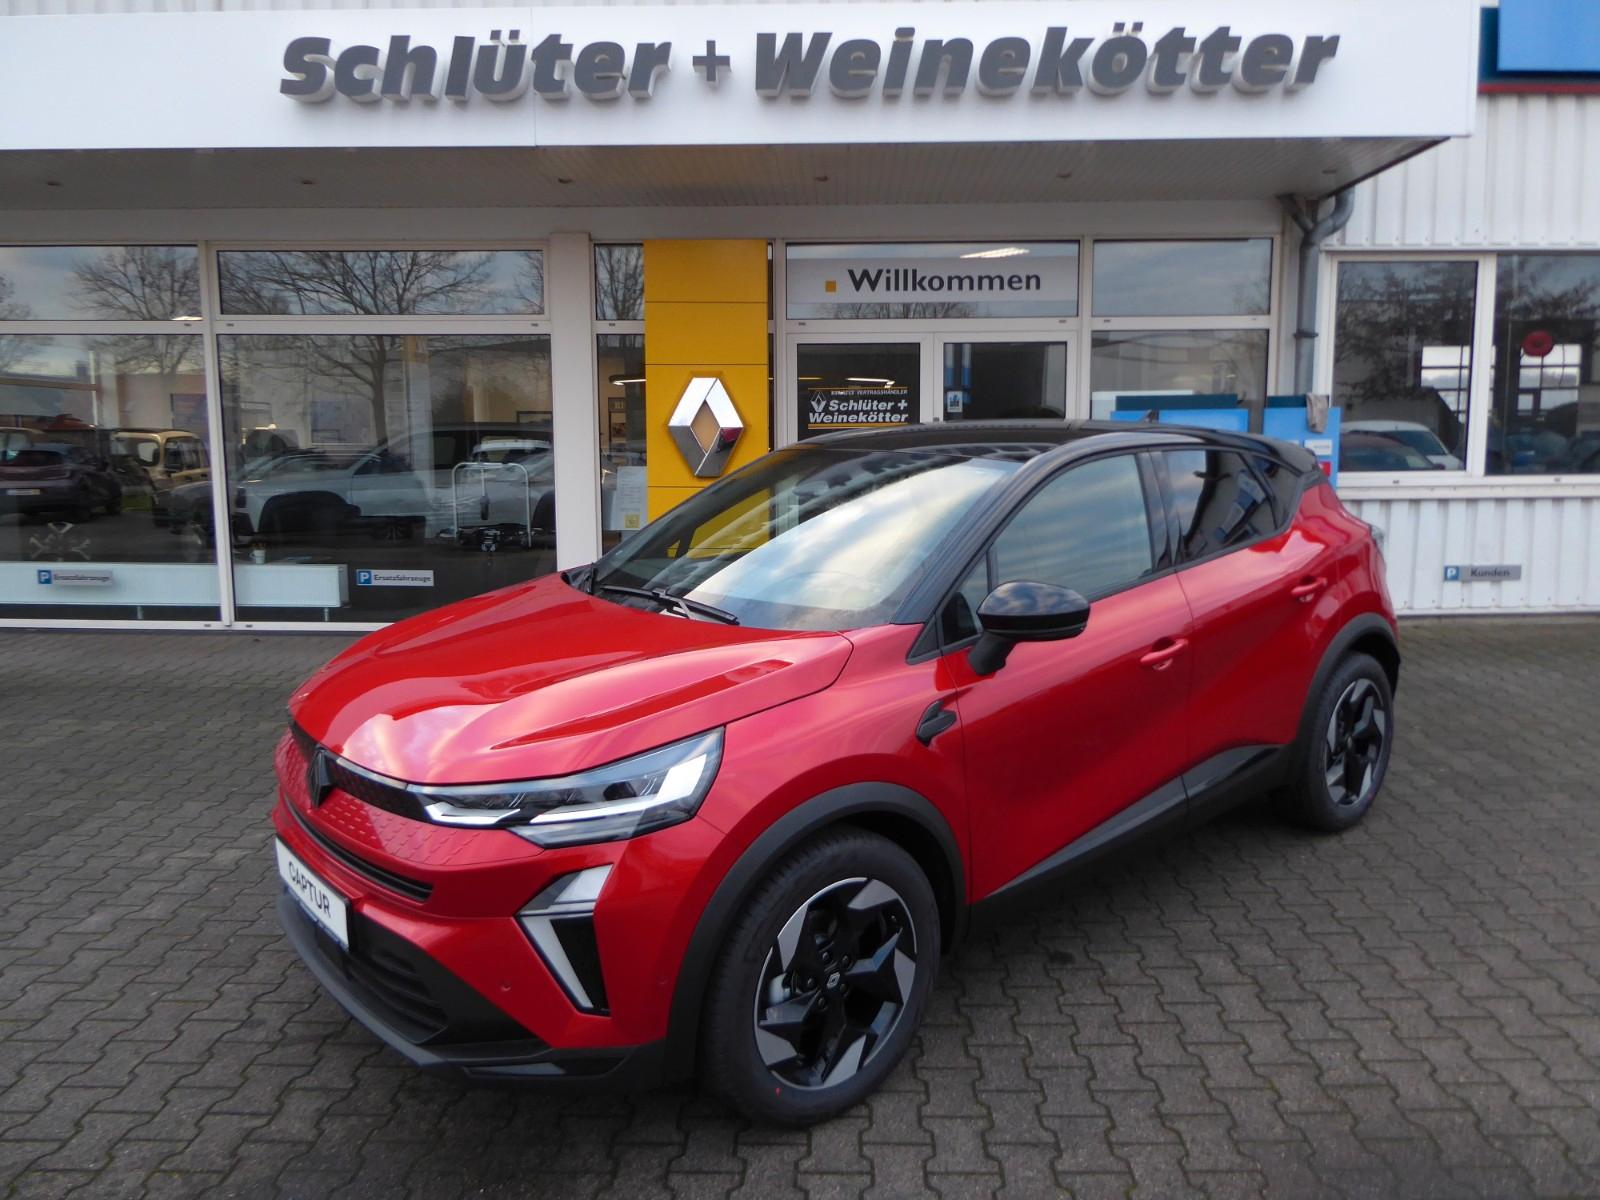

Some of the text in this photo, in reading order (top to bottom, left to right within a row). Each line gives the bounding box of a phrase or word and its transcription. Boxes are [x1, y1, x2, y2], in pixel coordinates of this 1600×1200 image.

[280, 22, 1340, 99] Schlüter + Weinekötter
[847, 268, 1041, 292] Willkommen
[828, 399, 908, 411] Schlüter +
[809, 411, 908, 423] Weinekötter
[1470, 567, 1511, 577] Kunden
[374, 574, 432, 583] Ersatzfahrzeuge
[288, 861, 331, 918] CAPTUR
